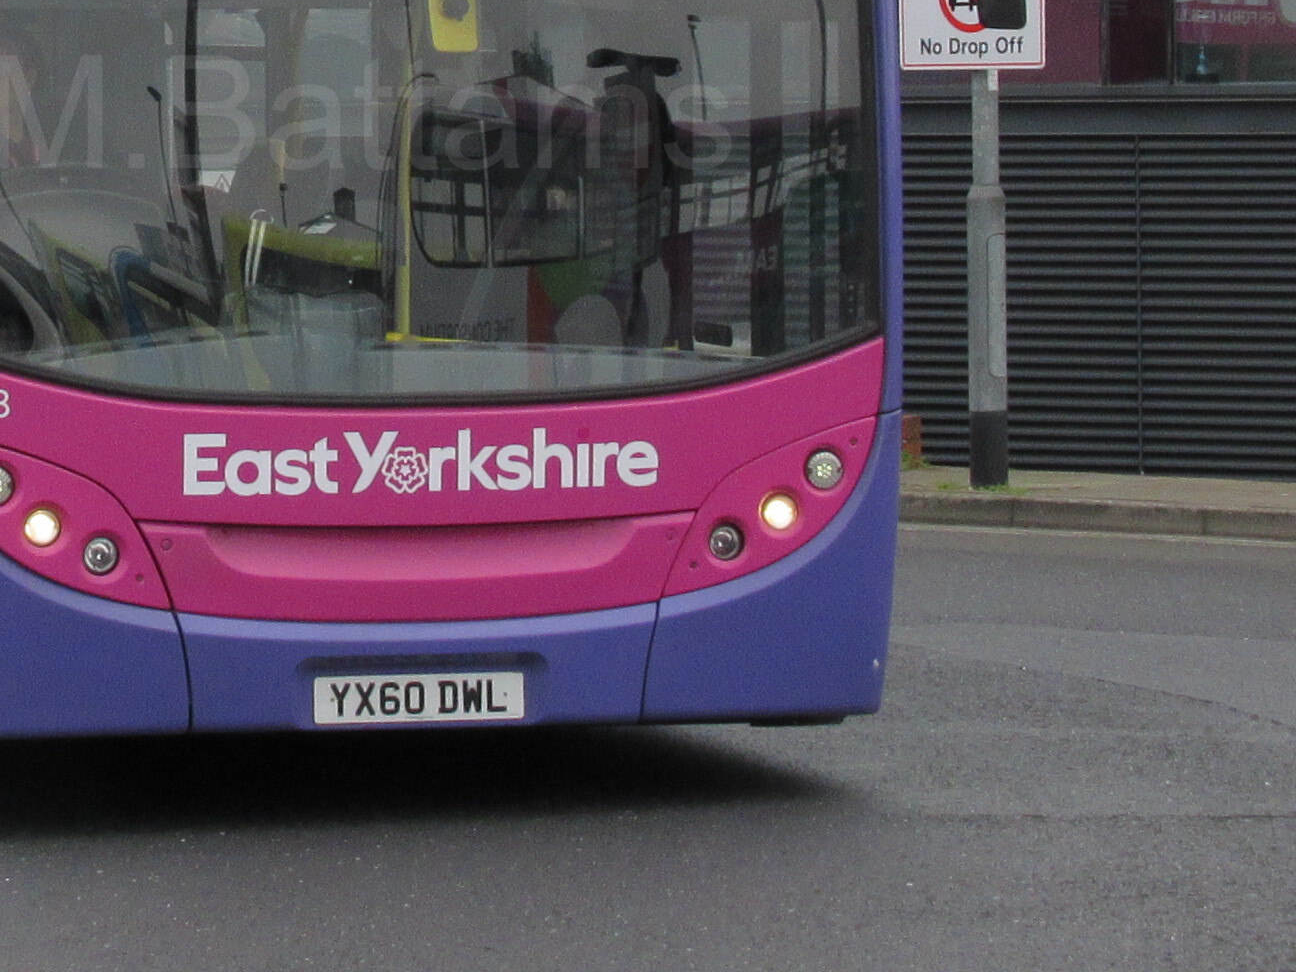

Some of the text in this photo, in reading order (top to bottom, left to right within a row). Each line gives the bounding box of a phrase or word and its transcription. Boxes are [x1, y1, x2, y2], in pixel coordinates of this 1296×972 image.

[920, 36, 1024, 59] No Drop Off
[183, 429, 658, 497] East Yorkshire
[330, 681, 507, 716] YX60 DWL
